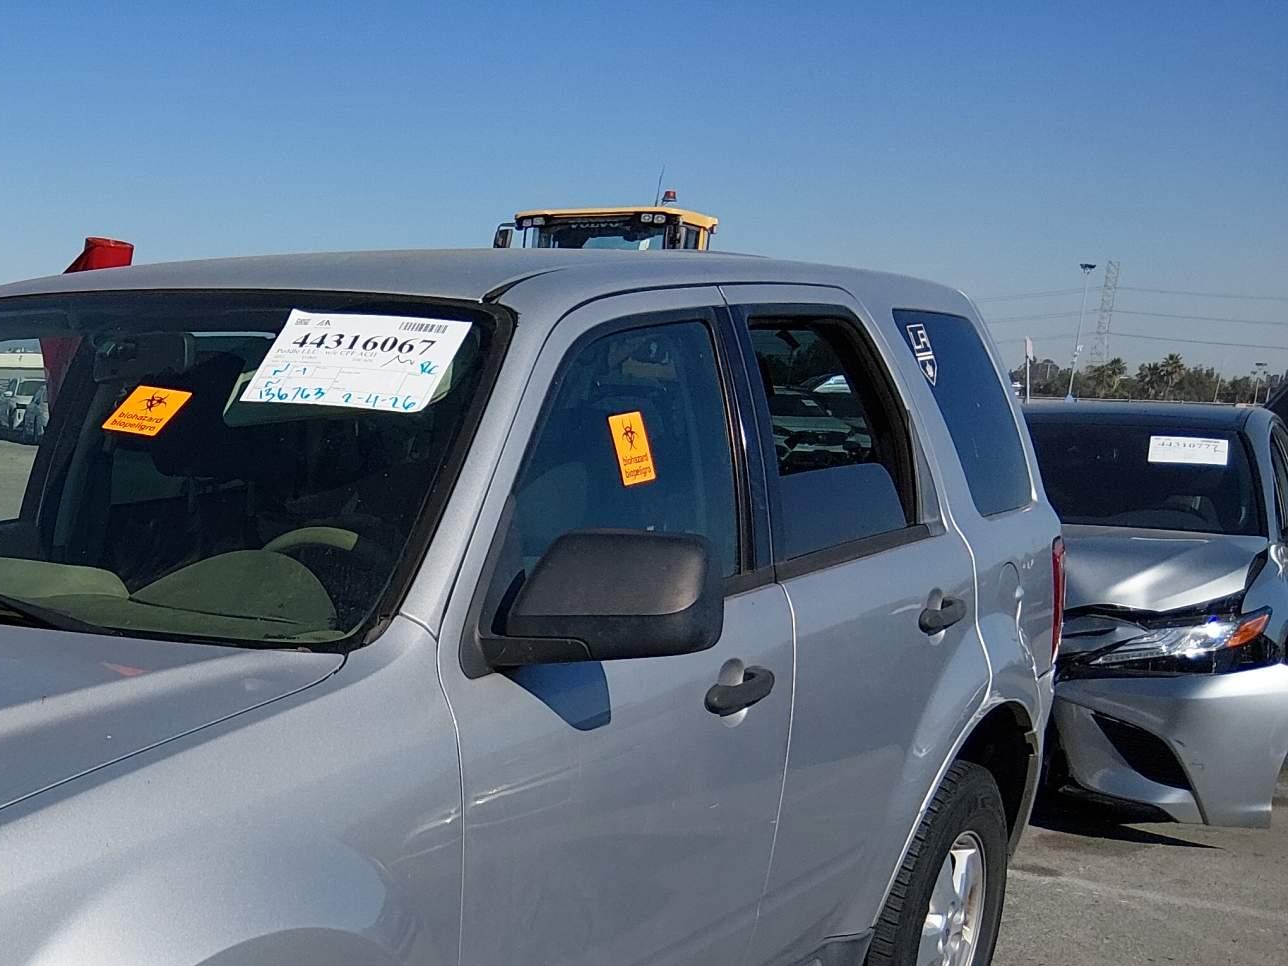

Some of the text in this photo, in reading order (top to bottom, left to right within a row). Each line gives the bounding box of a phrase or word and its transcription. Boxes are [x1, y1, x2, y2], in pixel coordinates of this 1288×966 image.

[292, 332, 437, 355] 44316067
[118, 411, 163, 424] biohazard
[110, 419, 155, 431] biopeligro
